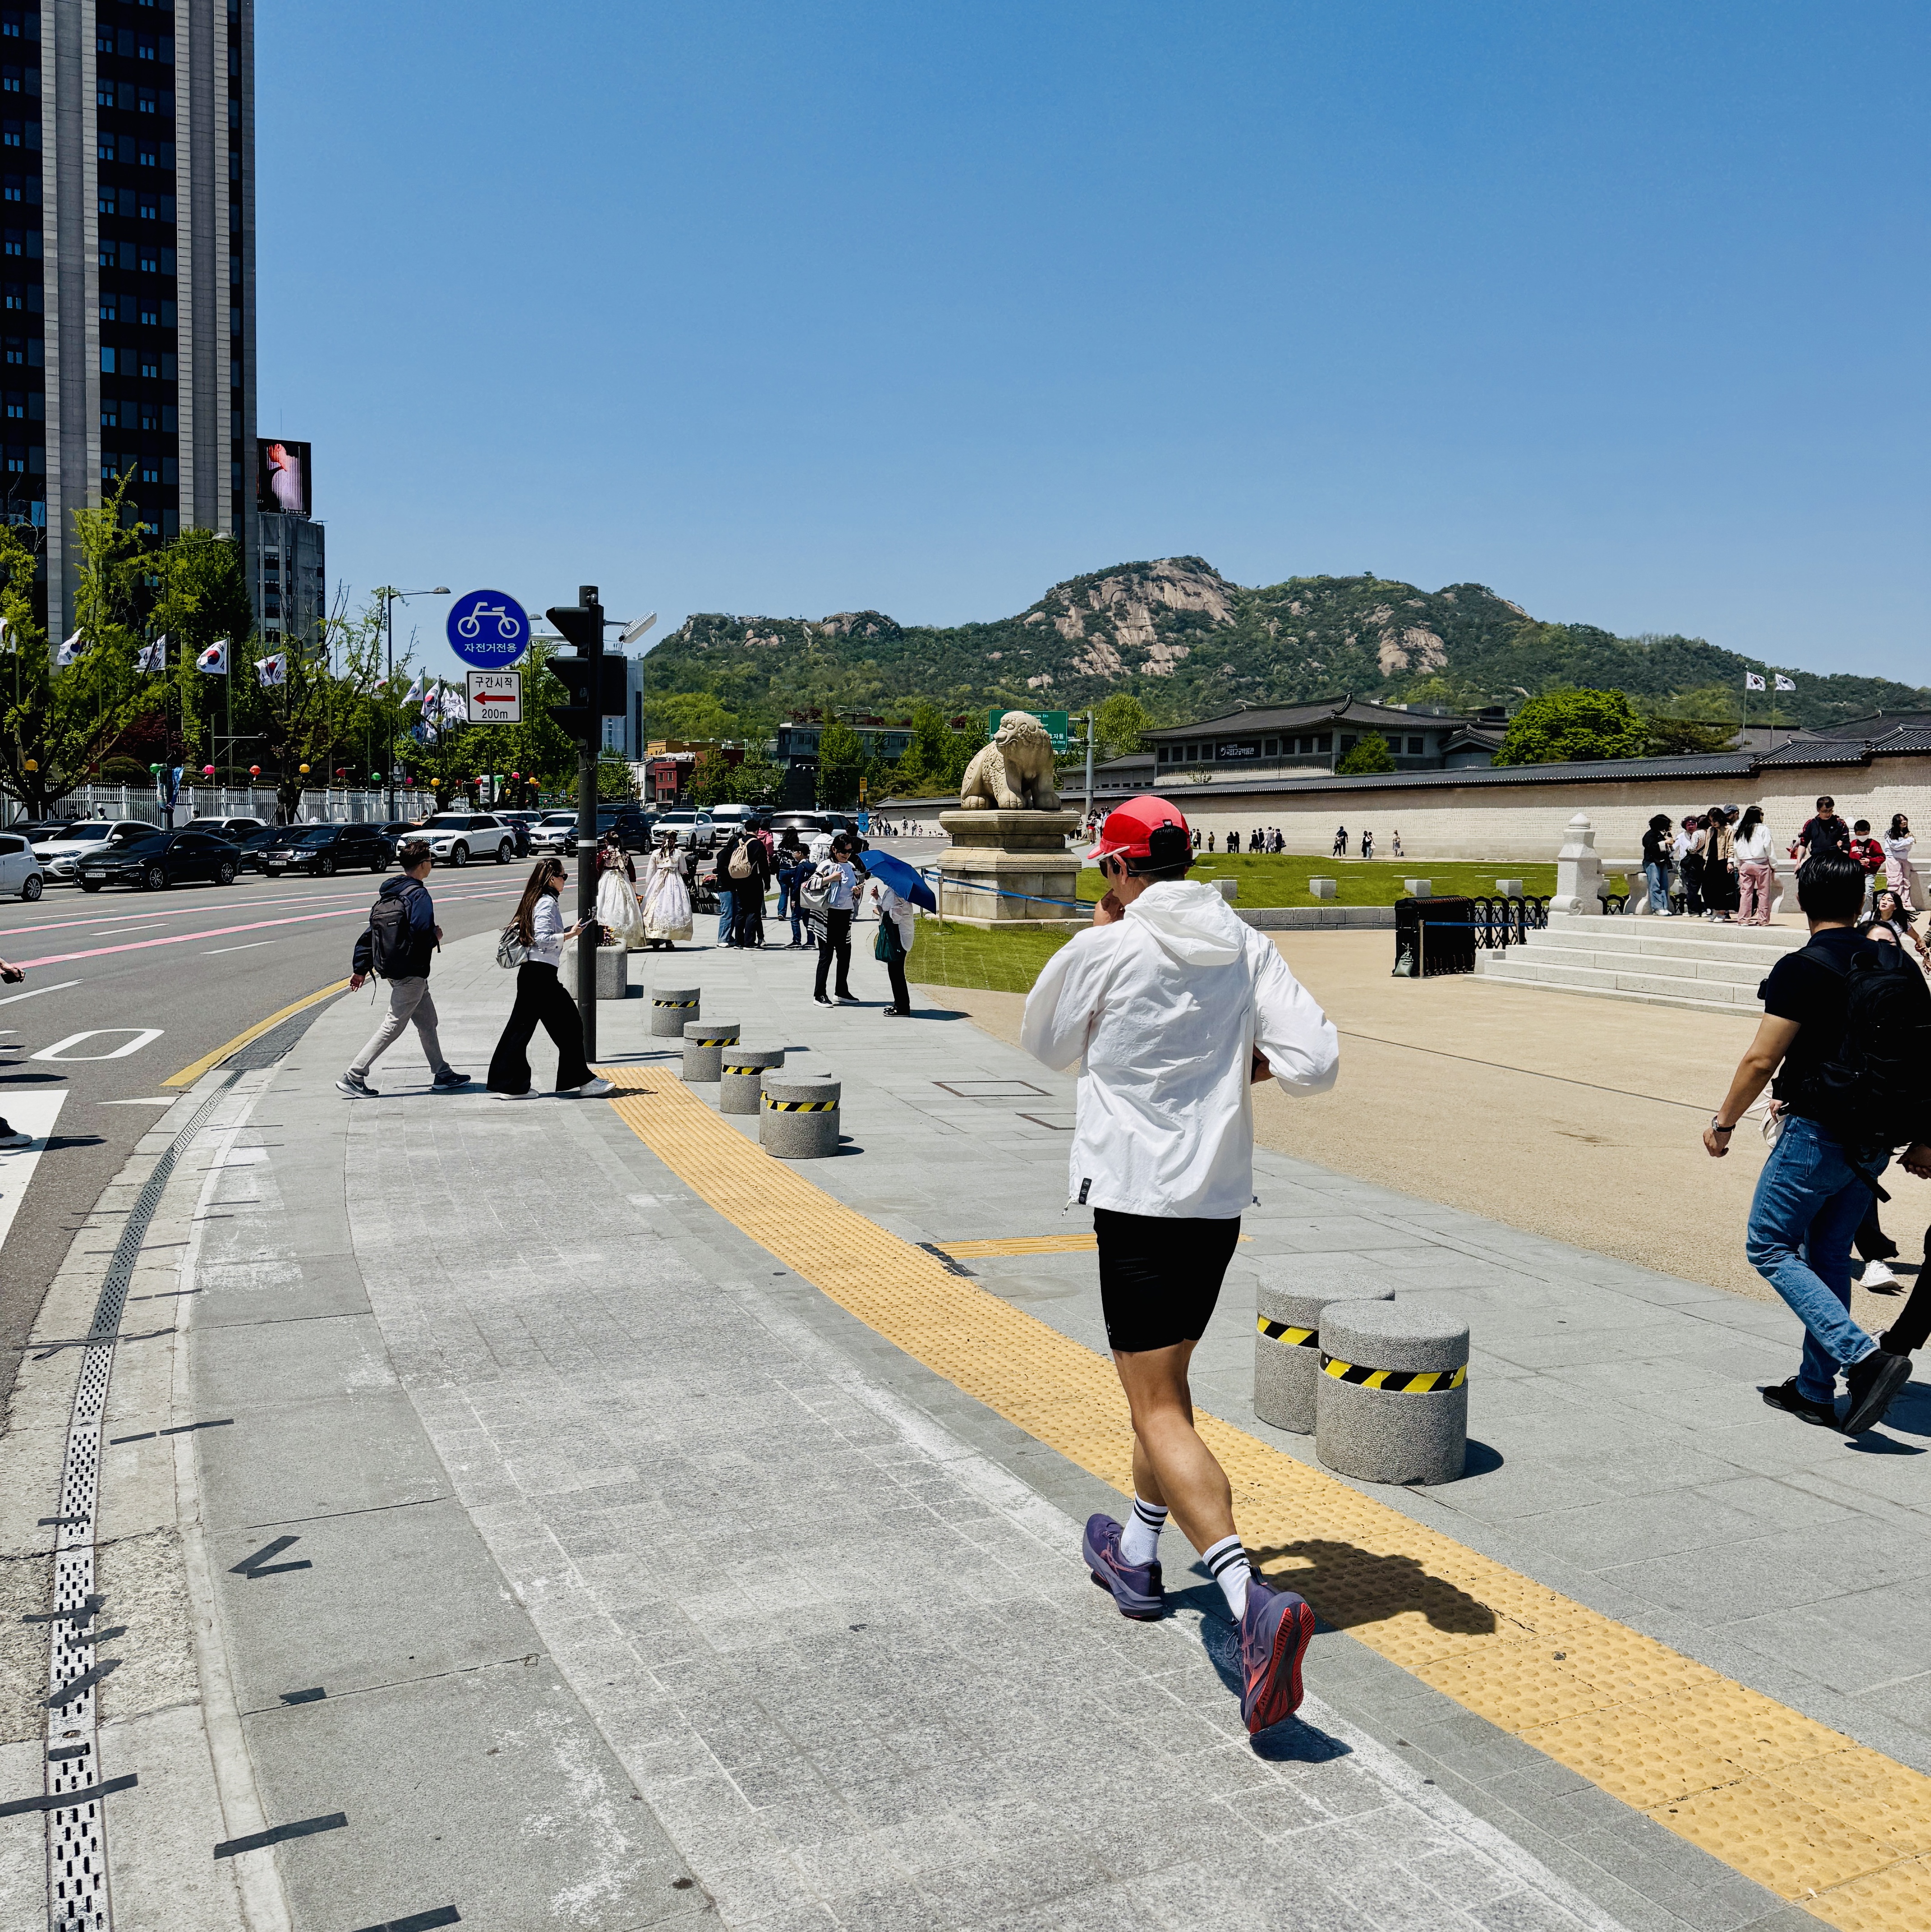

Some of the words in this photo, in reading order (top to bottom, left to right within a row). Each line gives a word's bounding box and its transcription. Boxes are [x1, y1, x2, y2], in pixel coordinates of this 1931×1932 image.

[464, 643, 517, 652] 자전거전용
[475, 677, 512, 688] 구간시작
[482, 709, 508, 719] 200m
